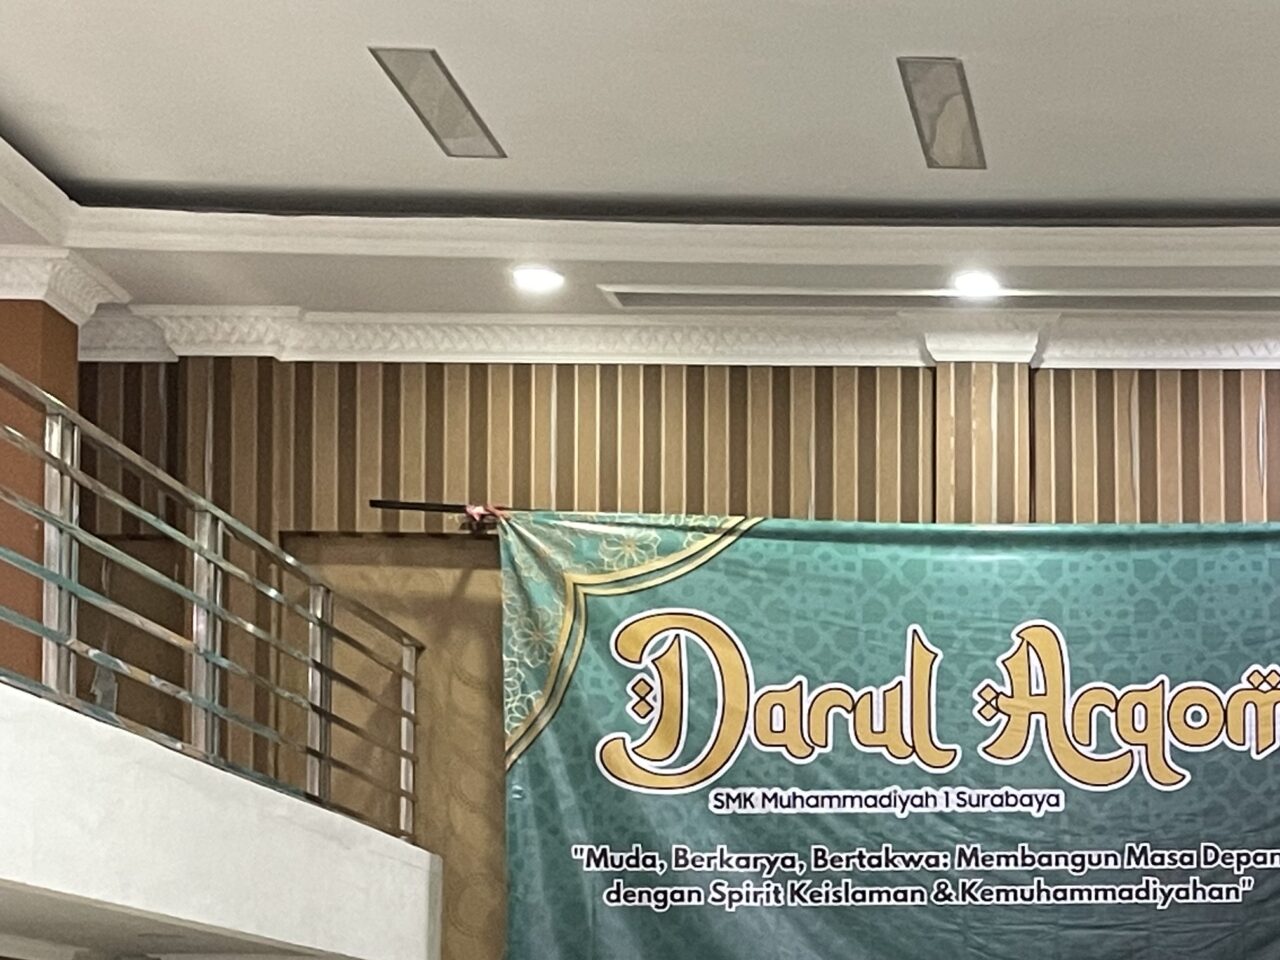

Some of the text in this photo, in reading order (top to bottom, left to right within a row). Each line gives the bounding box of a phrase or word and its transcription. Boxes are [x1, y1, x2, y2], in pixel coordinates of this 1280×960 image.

[599, 609, 958, 792] Darul
[712, 788, 1061, 814] SMK Muhammadiyah 1 Surabaya
[573, 846, 665, 874] "Muda,
[674, 848, 806, 877] Berkarya,
[813, 845, 949, 869] Bertakwa:
[956, 845, 1118, 873] Membangun
[1125, 845, 1196, 868] Masa
[605, 879, 1254, 909] dengan Spirit Keislaman & Kemuhammadiyahan"
